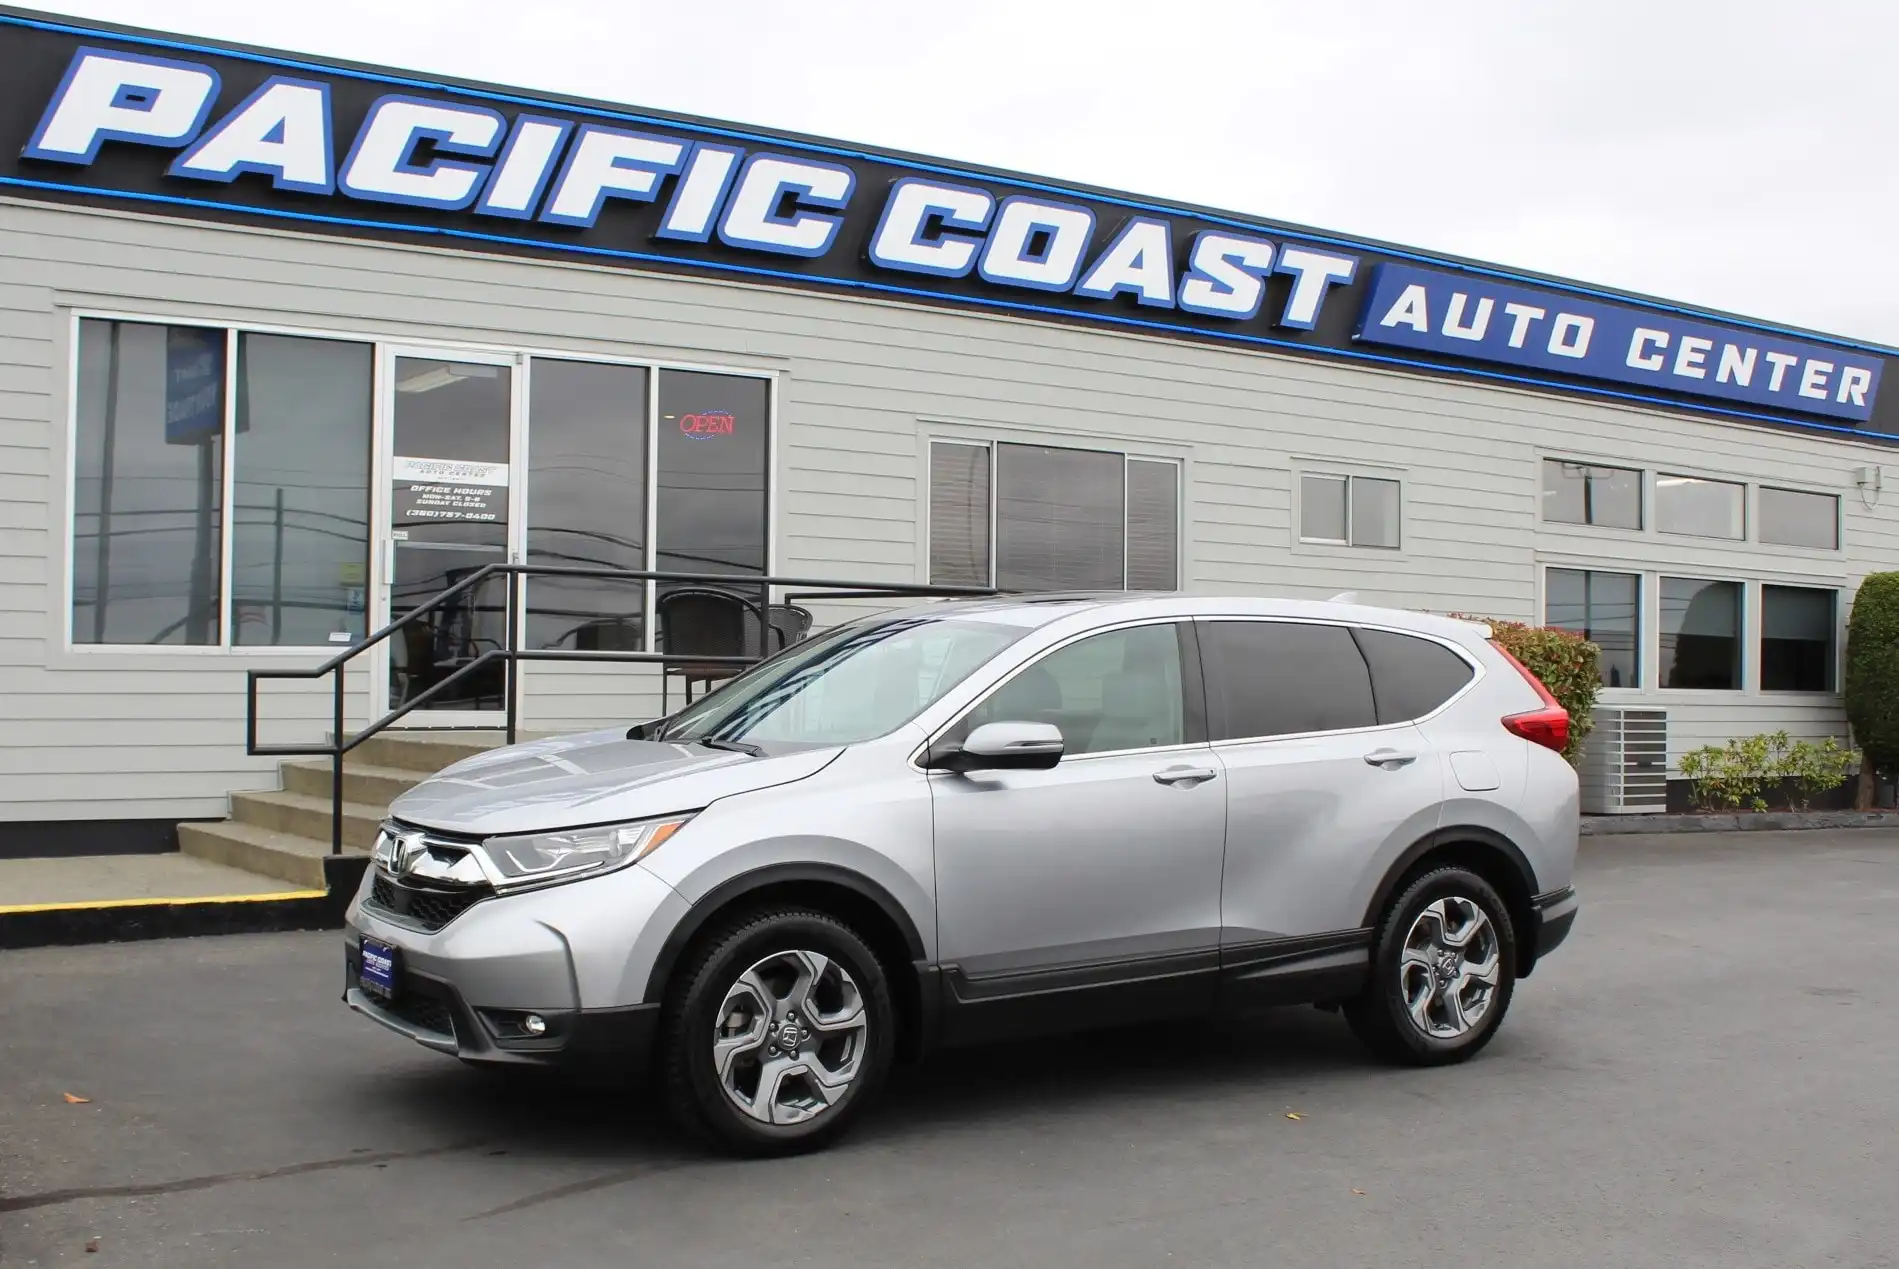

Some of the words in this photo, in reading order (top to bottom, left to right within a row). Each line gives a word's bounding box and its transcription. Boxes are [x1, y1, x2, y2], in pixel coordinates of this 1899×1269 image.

[21, 46, 856, 257] PACIFIC
[869, 177, 1361, 331] COAST
[1380, 284, 1595, 359] AUTO
[1626, 327, 1872, 406] CENTER
[680, 414, 735, 434] OPEN
[410, 485, 452, 493] OFFICE
[453, 487, 492, 496] HOURS
